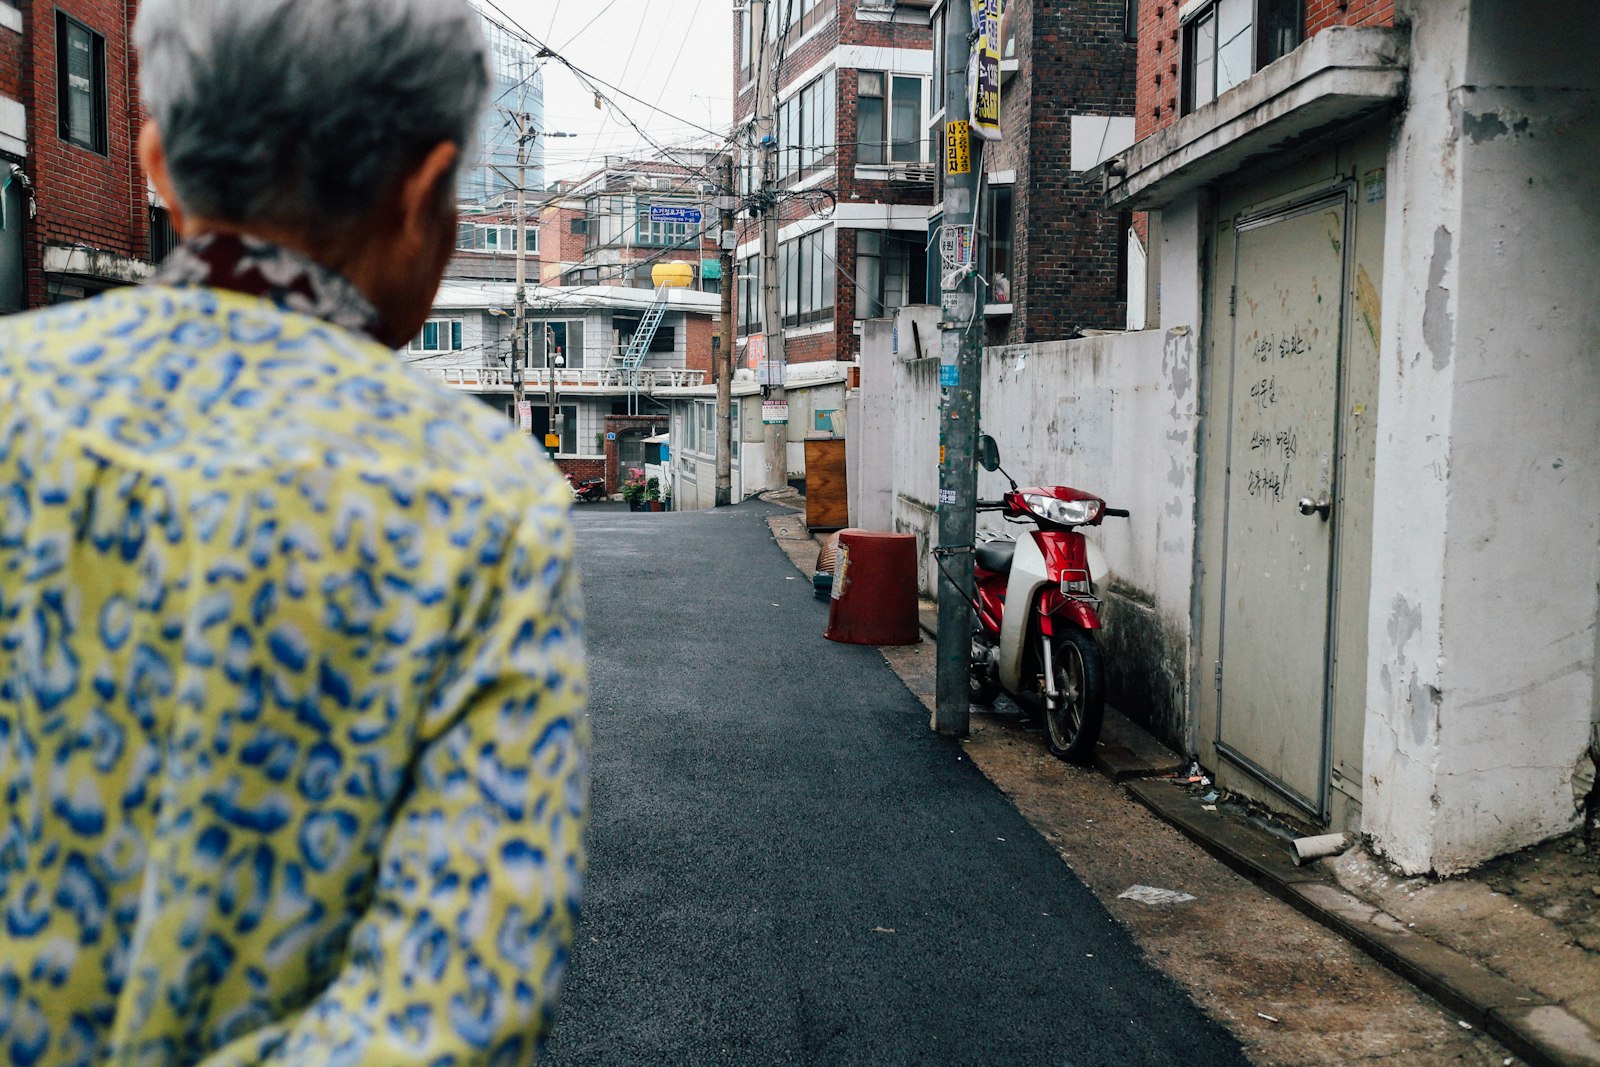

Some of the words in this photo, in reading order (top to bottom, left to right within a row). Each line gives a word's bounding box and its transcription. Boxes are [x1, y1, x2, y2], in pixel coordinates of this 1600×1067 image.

[947, 123, 958, 172] 사다리차
[1253, 333, 1275, 365] 사람이
[1250, 431, 1272, 459] 쓰레기
